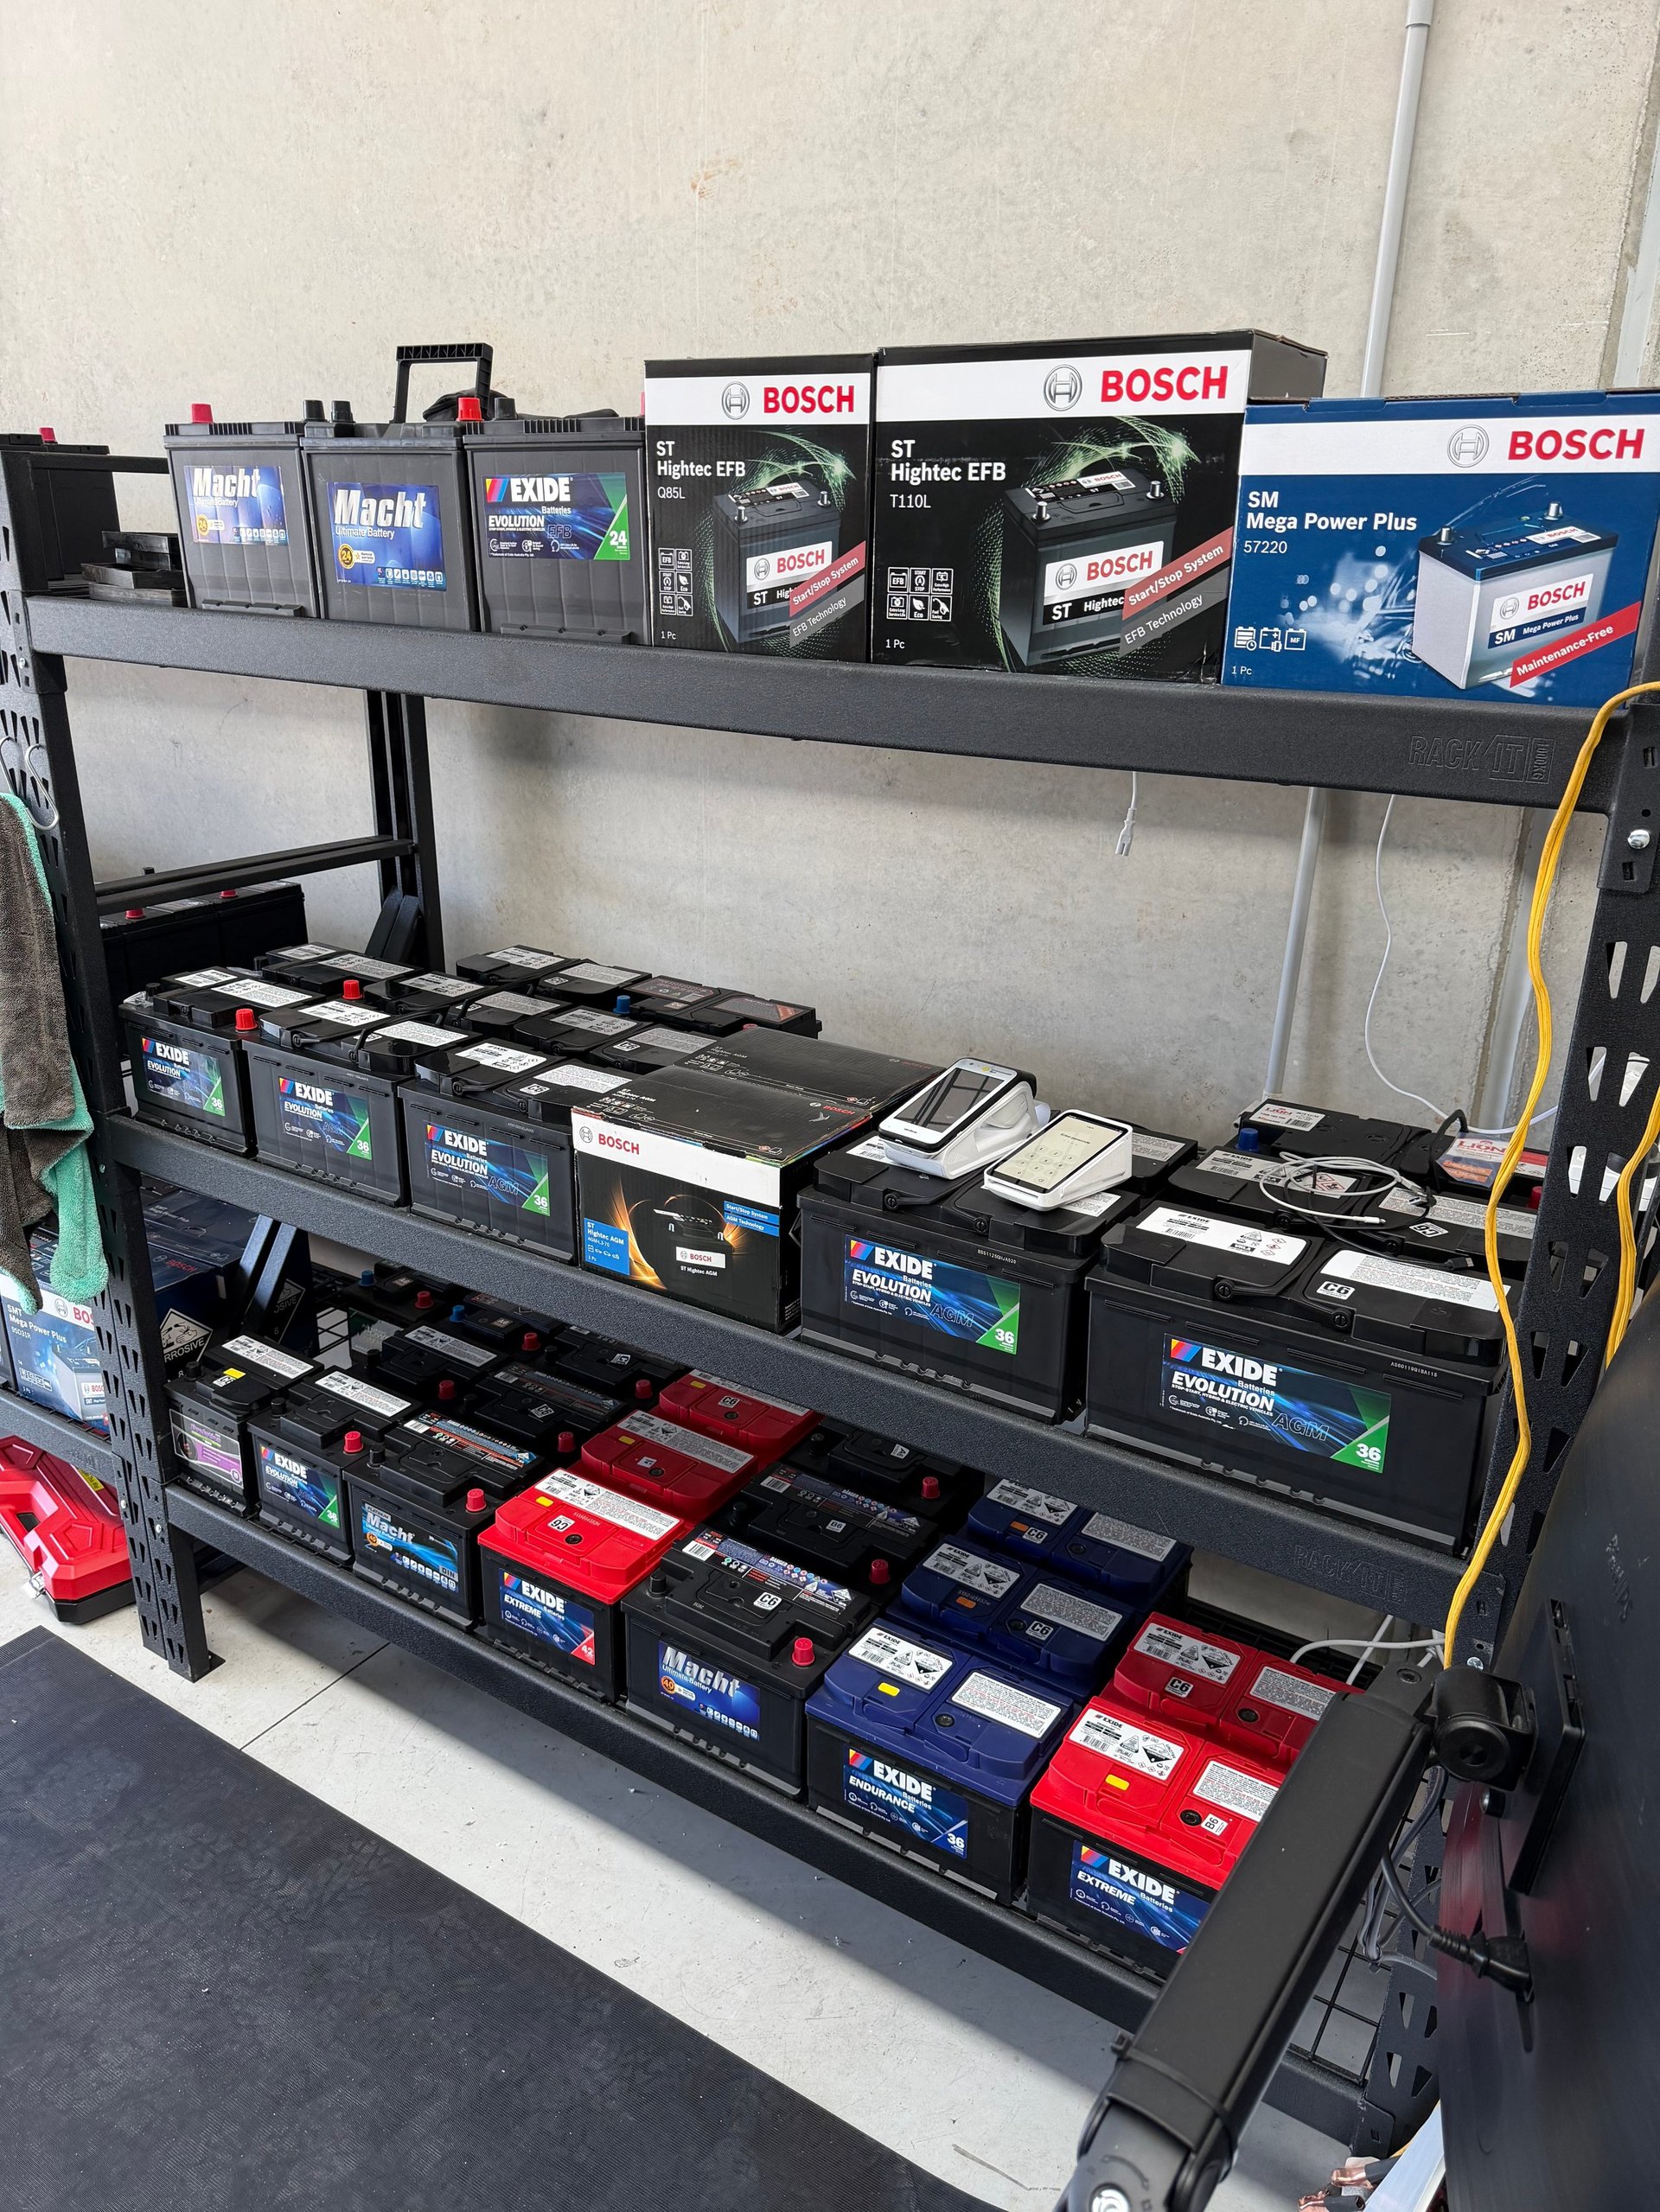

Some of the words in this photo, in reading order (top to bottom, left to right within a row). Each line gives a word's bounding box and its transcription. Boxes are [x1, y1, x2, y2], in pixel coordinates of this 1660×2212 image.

[1101, 366, 1229, 403] BOSCH
[763, 386, 854, 413] BOSCH
[656, 441, 674, 456] ST
[891, 439, 915, 458] ST
[1508, 429, 1644, 461] BOSCH
[657, 462, 712, 479] Hightec
[717, 462, 745, 477] EFB
[891, 463, 961, 484] Hightec
[968, 462, 1006, 481] EFB
[1094, 473, 1122, 483] BOSCH
[193, 468, 260, 498] Macht
[510, 477, 571, 501] EXIDE
[658, 487, 686, 500] Q85L
[891, 494, 931, 508] T110L
[1248, 491, 1279, 508] SM
[335, 489, 426, 529] Macht
[541, 507, 571, 515] Batteries
[488, 515, 545, 527] EVOLUTION
[1247, 513, 1297, 534] Mega
[1305, 514, 1368, 530] Power
[1373, 513, 1417, 531] Plus
[335, 526, 366, 537] Ultimate
[367, 527, 395, 540] Battery
[546, 525, 572, 539] EFB
[610, 531, 628, 546] 24
[1546, 527, 1576, 541] BOSCH
[341, 550, 352, 561] 24
[1243, 540, 1287, 554] 57220
[776, 549, 825, 573] BOSCH
[1087, 551, 1152, 581] BOSCH
[793, 576, 830, 606] Start/Stop
[831, 557, 859, 583] System
[1127, 569, 1183, 606] Start/Stop
[1184, 544, 1224, 575] System
[754, 590, 768, 605] ST
[1527, 581, 1586, 610] BOSCH
[793, 622, 808, 637] EFB
[807, 596, 846, 628] Technology
[1051, 602, 1071, 620] ST
[1083, 596, 1124, 612] Hightec
[1125, 627, 1146, 644] EFB
[1146, 594, 1204, 633] Technology
[1494, 629, 1516, 646] SM
[1523, 624, 1538, 635] Mega
[1538, 618, 1561, 632] Power
[1563, 614, 1579, 627] Plus
[885, 639, 891, 647] 1
[894, 639, 905, 648] Pc
[1516, 625, 1613, 676] Maintenance-Free
[1232, 666, 1236, 675] 1
[1240, 666, 1252, 676] Pc
[1408, 736, 1484, 771] RACK
[156, 1042, 189, 1065] EXIDE
[147, 1061, 181, 1077] EVOLUTION
[294, 1081, 334, 1106] EXIDE
[527, 1084, 545, 1093] C6
[211, 1098, 223, 1108] 36
[284, 1101, 322, 1119] EVOLUTION
[822, 1106, 855, 1116] BOSCH
[356, 1139, 369, 1151] 36
[444, 1130, 488, 1156] EXIDE
[598, 1133, 640, 1155] BOSCH
[1458, 1140, 1507, 1154] LION
[431, 1149, 488, 1176] EVOLUTION
[466, 1153, 488, 1163] Batteries
[488, 1176, 519, 1195] AGM
[533, 1195, 548, 1207] 36
[726, 1203, 752, 1215] Start/Stop
[751, 1209, 769, 1220] System
[738, 1218, 765, 1230] Technology
[587, 1228, 610, 1241] Hightec
[610, 1234, 624, 1245] AGM
[166, 1259, 198, 1272] BOSCH
[690, 1253, 712, 1263] BOSCH
[874, 1246, 933, 1279] EXIDE
[686, 1266, 705, 1275] Hightec
[852, 1269, 933, 1302] EVOLUTION
[903, 1275, 933, 1288] Batteries
[1322, 1281, 1350, 1296] C6
[8, 1304, 22, 1316] SMT
[929, 1303, 974, 1328] AGM
[10, 1315, 29, 1328] Mega
[29, 1323, 50, 1336] Power
[51, 1330, 67, 1343] Plus
[994, 1328, 1015, 1344] 36
[1202, 1348, 1278, 1386] EXIDE
[1172, 1371, 1274, 1412] EVOLUTION
[1237, 1380, 1275, 1397] Batteries
[725, 1396, 737, 1406] C6
[1171, 1383, 1202, 1397] STOP-START,
[1202, 1393, 1221, 1401] HYBRID
[1225, 1399, 1248, 1409] ELECTRIC
[1248, 1405, 1274, 1417] VEHICLES
[1272, 1413, 1330, 1442] AGM
[1356, 1444, 1382, 1461] 36
[274, 1452, 308, 1479] EXIDE
[265, 1465, 298, 1487] EVOLUTION
[327, 1509, 337, 1521] 36
[366, 1512, 415, 1544] Macht
[551, 1519, 569, 1530] C6
[830, 1520, 842, 1529] B6
[1029, 1527, 1044, 1539] C6
[770, 1556, 788, 1566] DANGER
[442, 1568, 456, 1578] DIN
[521, 1580, 565, 1614] EXIDE
[759, 1593, 777, 1606] C6
[504, 1594, 542, 1619] EXTREME
[544, 1605, 565, 1621] Batteries
[1033, 1622, 1051, 1635] C6
[1164, 1629, 1184, 1640] EXIDE
[884, 1635, 901, 1645] EXIDE
[581, 1645, 594, 1656] 42
[662, 1646, 741, 1698] Macht
[662, 1664, 689, 1681] Ultimate
[689, 1677, 712, 1693] Battery
[663, 1679, 674, 1691] 40
[1170, 1677, 1189, 1692] C6
[1102, 1717, 1123, 1729] EXIDE
[873, 1759, 932, 1802] EXIDE
[849, 1775, 916, 1814] ENDURANCE
[902, 1792, 932, 1810] Batteries
[1205, 1817, 1219, 1830] B6
[947, 1833, 965, 1849] 36
[1077, 1871, 1136, 1906] EXTREME
[1108, 1858, 1176, 1904] EXIDE
[1140, 1891, 1173, 1913] Batteries
